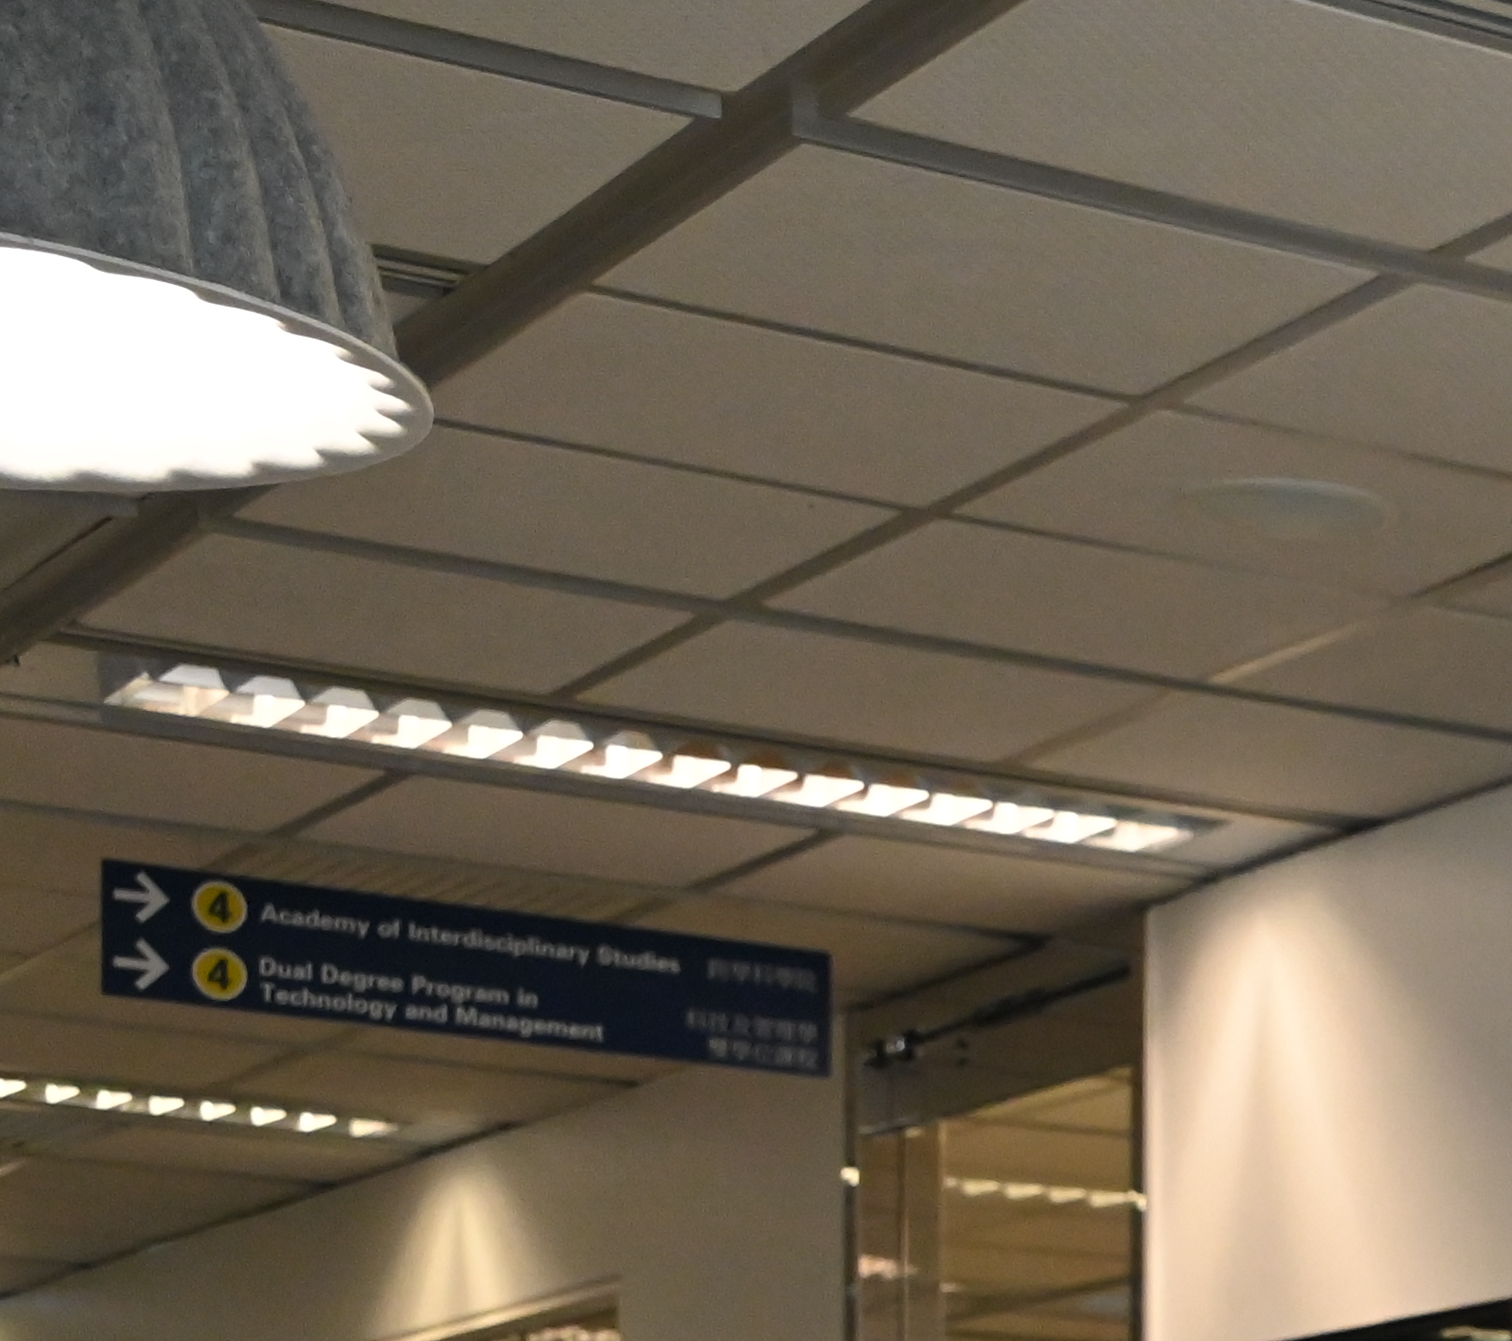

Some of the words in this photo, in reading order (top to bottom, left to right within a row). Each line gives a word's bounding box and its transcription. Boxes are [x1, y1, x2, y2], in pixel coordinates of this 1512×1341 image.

[208, 891, 231, 923] 4
[260, 902, 370, 939] Academy
[377, 919, 400, 940] of
[407, 921, 590, 967] Interdisciplinary
[596, 944, 681, 974] Studies
[207, 958, 230, 990] 4
[258, 955, 313, 982] Dual
[320, 963, 404, 993] Degree
[411, 974, 510, 1004] Program
[515, 986, 539, 1009] in
[260, 982, 398, 1022] Technology
[405, 1003, 448, 1024] and
[454, 1005, 604, 1043] Management
